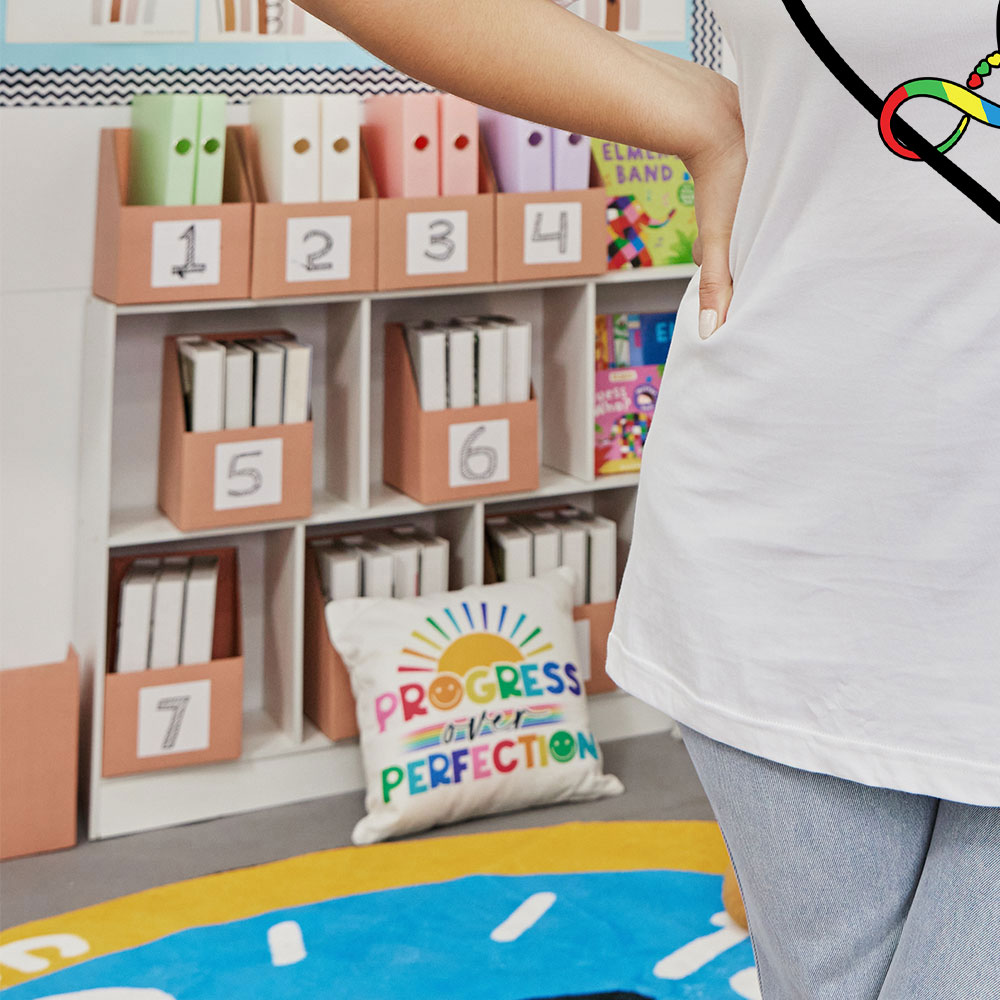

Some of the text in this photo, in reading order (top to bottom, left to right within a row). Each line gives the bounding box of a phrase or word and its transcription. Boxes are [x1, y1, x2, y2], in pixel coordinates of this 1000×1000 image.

[615, 164, 674, 184] BAND
[170, 224, 207, 280] 1
[301, 229, 335, 272] 2
[423, 219, 456, 261] 3
[531, 210, 568, 254] 4
[227, 450, 263, 498] 5
[458, 426, 499, 482] 6
[375, 661, 582, 734] PROGRESS
[156, 695, 191, 750] 7
[440, 709, 528, 745] over
[381, 729, 599, 804] PERFECTION
